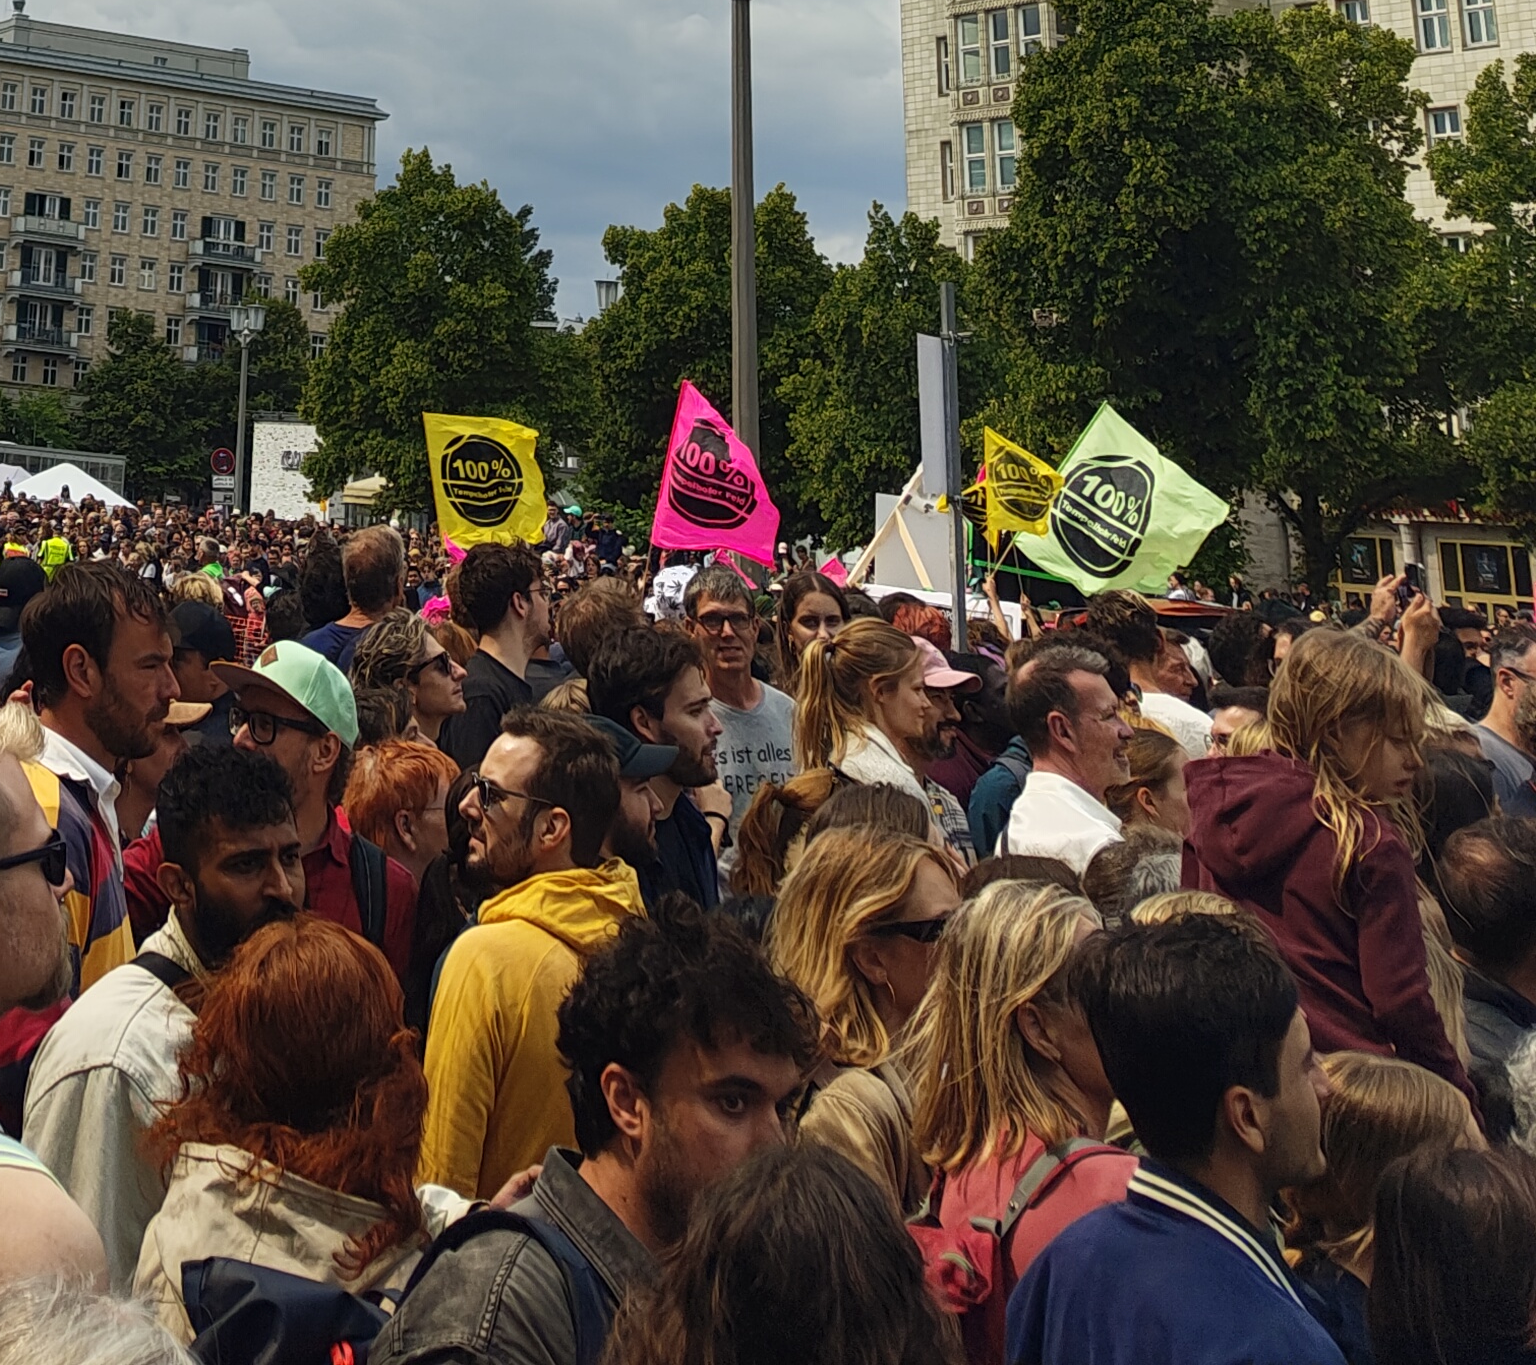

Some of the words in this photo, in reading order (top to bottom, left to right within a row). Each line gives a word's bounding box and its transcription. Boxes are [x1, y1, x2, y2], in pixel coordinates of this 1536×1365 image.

[1081, 474, 1142, 526] 100%
[731, 745, 753, 764] ist
[757, 741, 792, 763] alles
